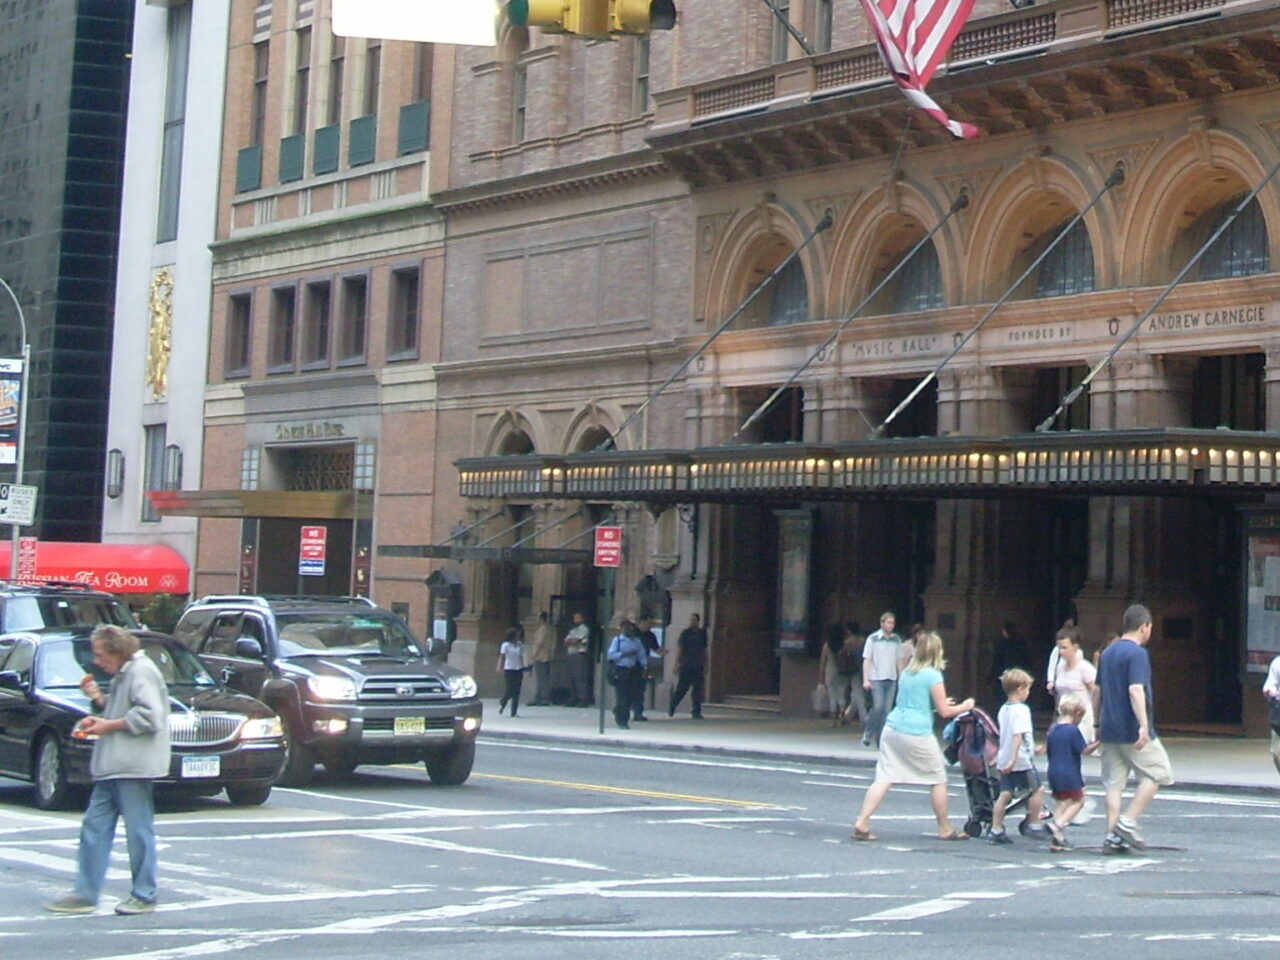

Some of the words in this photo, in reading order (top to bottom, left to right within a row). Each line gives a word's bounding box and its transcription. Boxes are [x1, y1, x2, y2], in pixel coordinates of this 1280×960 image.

[1149, 313, 1201, 332] ANDREW
[1204, 306, 1266, 327] CARNEGIE
[1059, 326, 1072, 338] BY
[104, 571, 149, 589] ROOM
